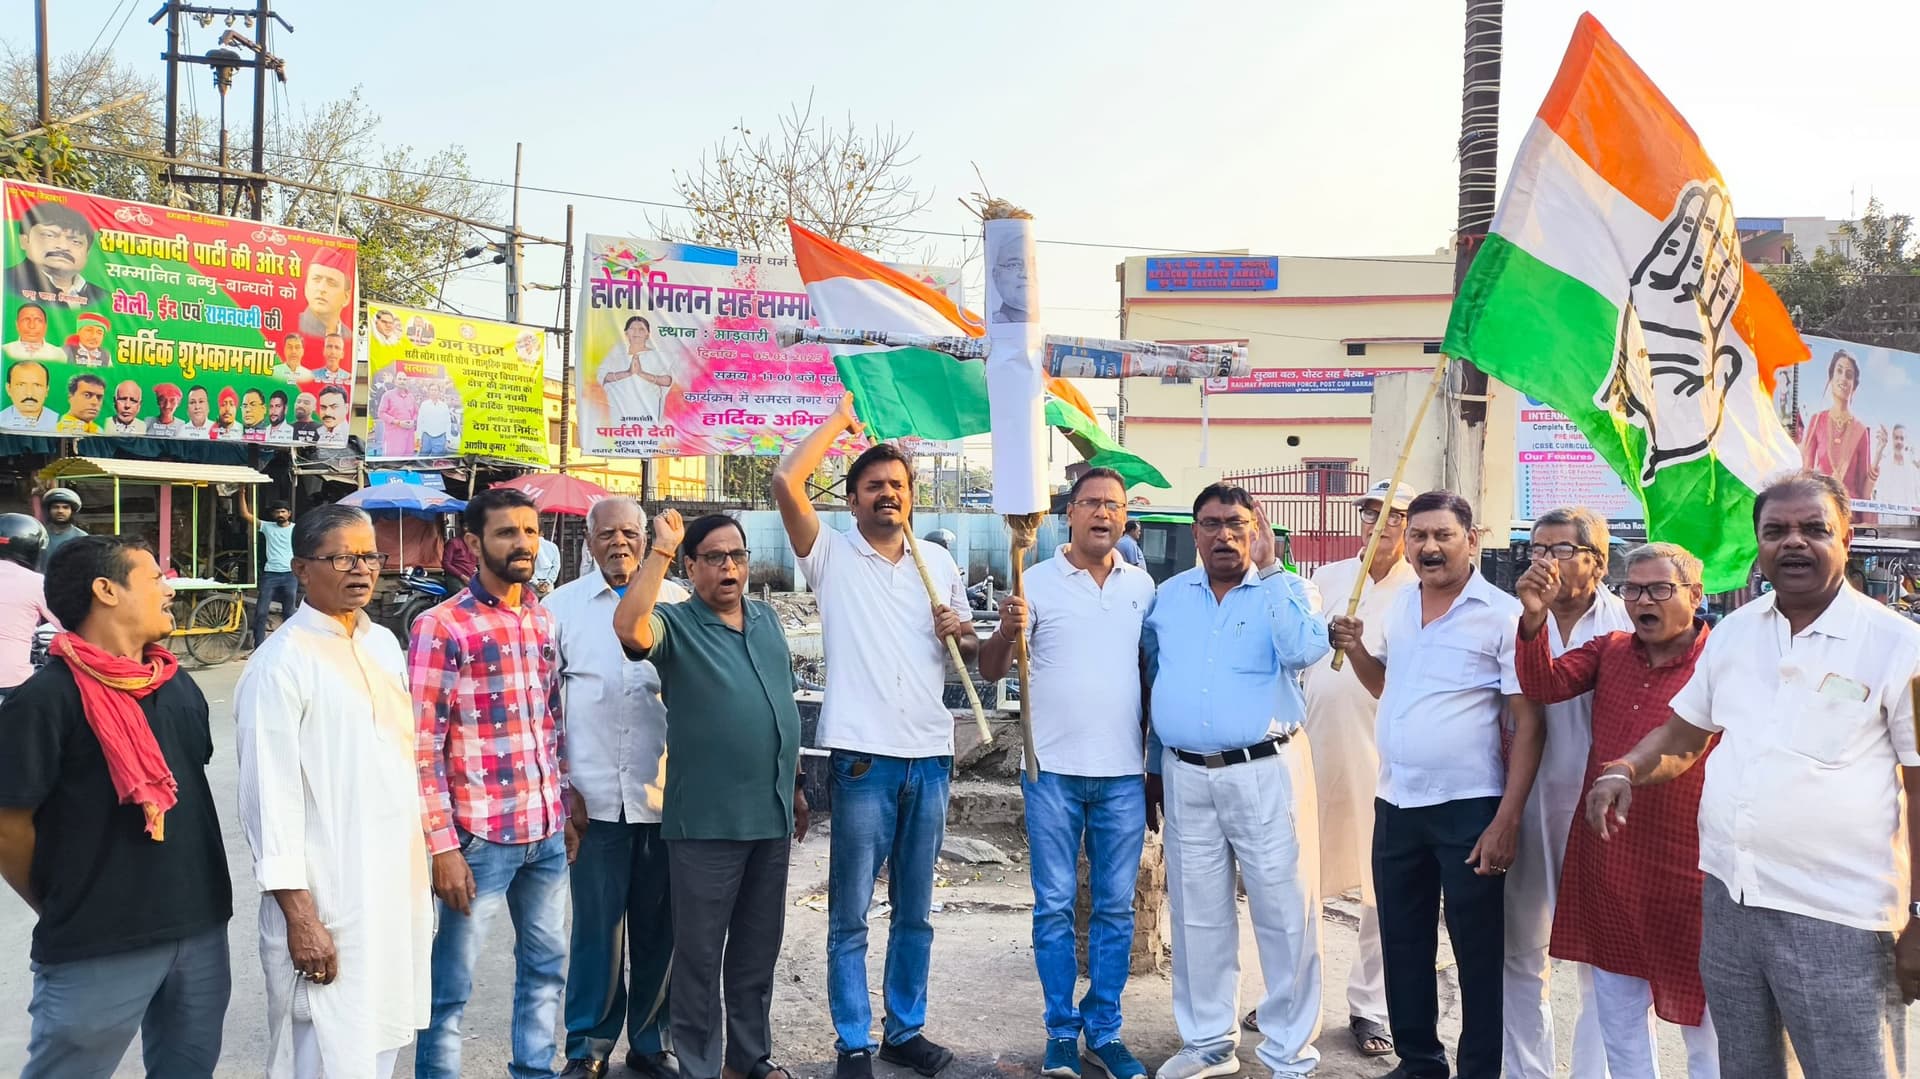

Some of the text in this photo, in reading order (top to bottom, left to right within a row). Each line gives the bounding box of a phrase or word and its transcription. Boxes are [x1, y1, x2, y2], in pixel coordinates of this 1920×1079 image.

[99, 228, 301, 277] समाजवादी पार्टी की ओर से
[740, 253, 787, 267] सर्व धर्म
[105, 263, 180, 285] सम्मानित
[279, 282, 297, 300] को
[590, 266, 817, 320] होली मिलन सह सम्मा
[112, 290, 154, 320] होली,
[158, 295, 179, 321] ईद
[181, 300, 203, 321] एवं
[205, 304, 262, 328] रामनवमी
[265, 309, 282, 331] की
[658, 326, 698, 338] स्थान
[714, 328, 769, 344] माड़वारी
[117, 328, 175, 367] हार्दिक
[179, 341, 276, 379] शुभकामनाएँ
[437, 338, 505, 356] जन सुराज
[714, 372, 748, 380] समय
[795, 372, 815, 382] बजे
[1302, 369, 1323, 378] पोस्ट
[1325, 370, 1340, 378] सह
[684, 390, 733, 403] कार्यक्रम
[739, 391, 749, 403] में
[754, 394, 791, 404] समस्त
[796, 395, 821, 405] नगर
[472, 420, 490, 430] देश
[493, 424, 511, 432] राज
[702, 409, 767, 426] हार्दिक
[596, 424, 675, 437] पार्वती देवी
[1566, 424, 1577, 432] Eng
